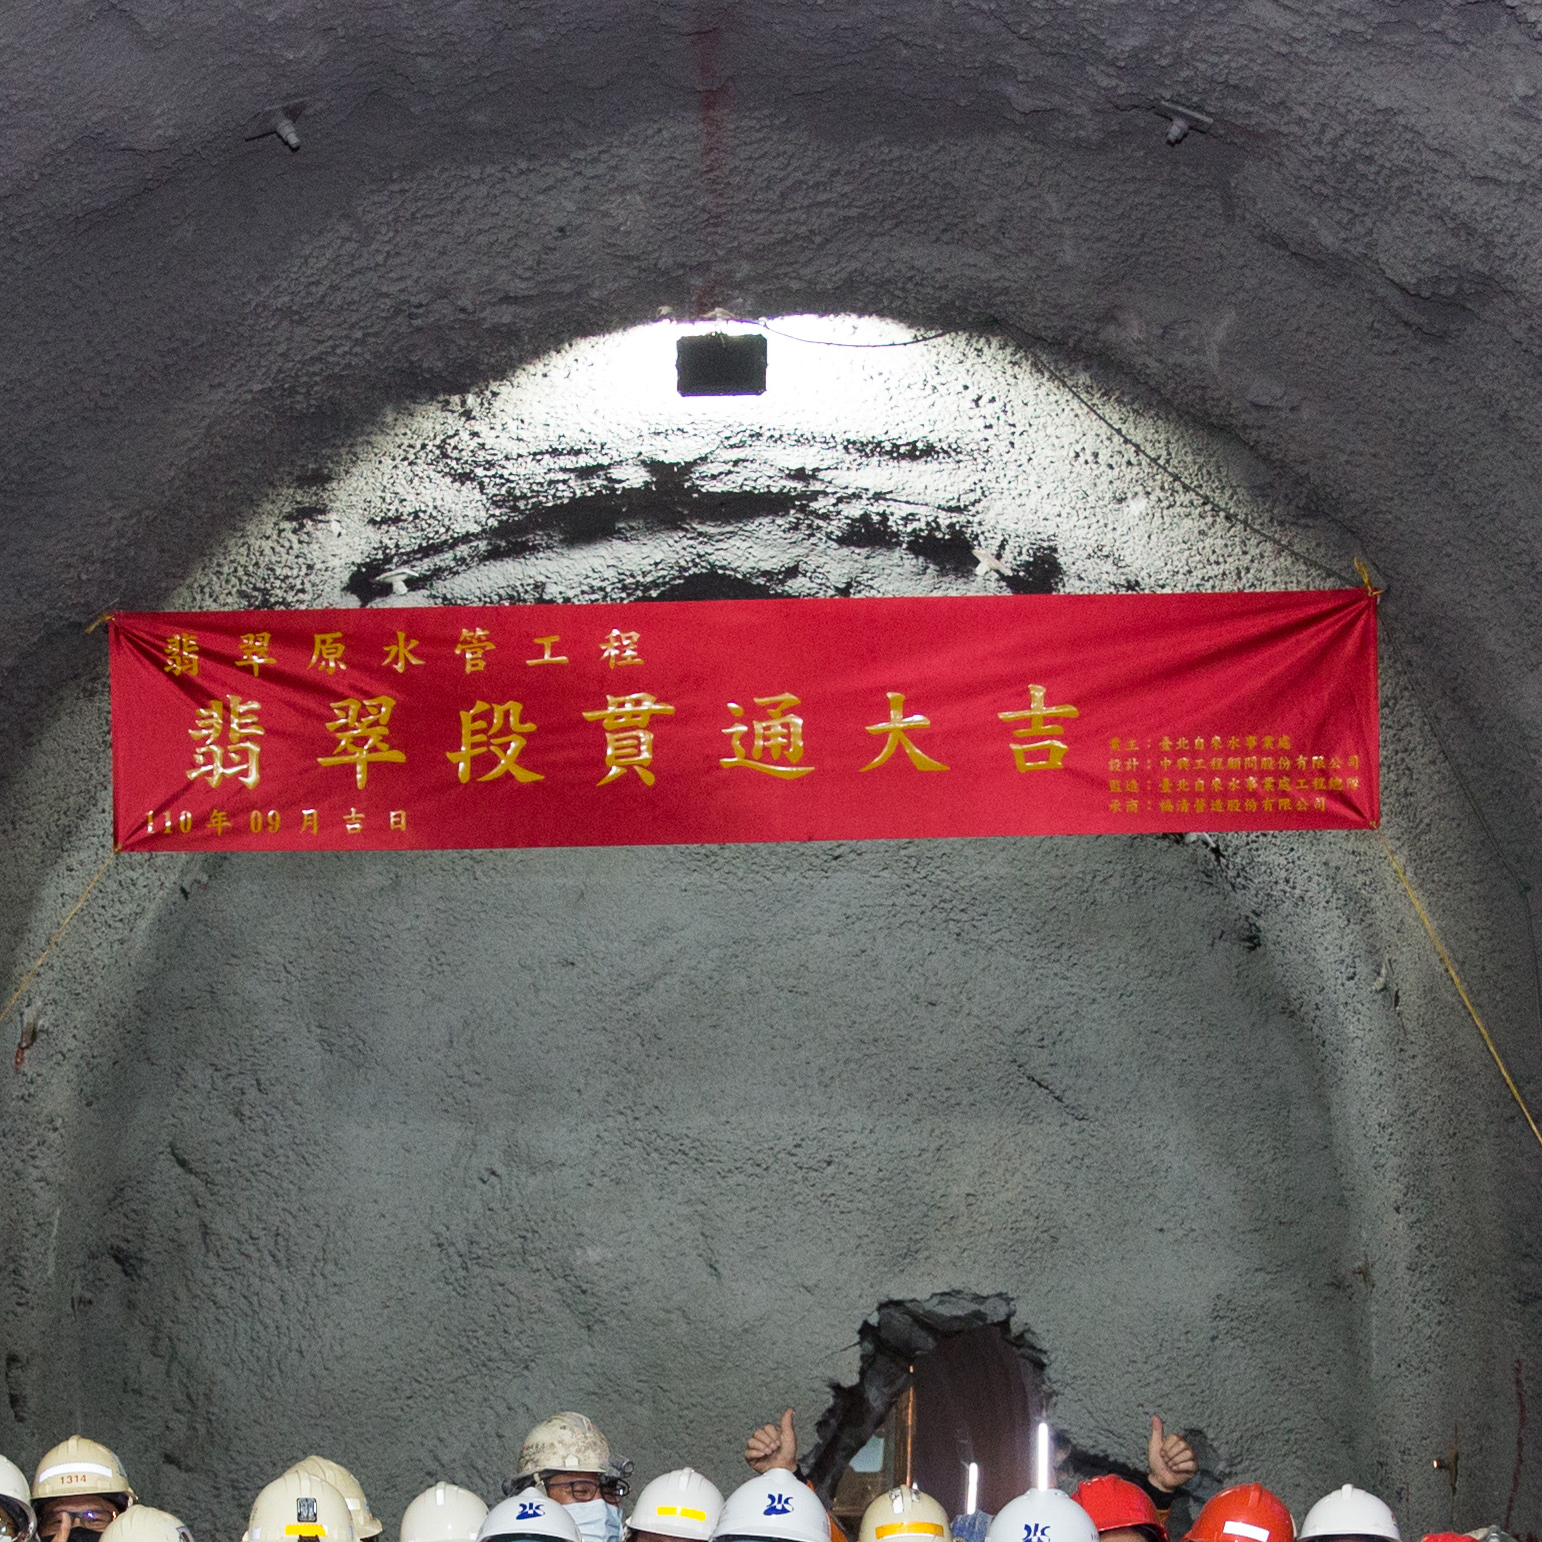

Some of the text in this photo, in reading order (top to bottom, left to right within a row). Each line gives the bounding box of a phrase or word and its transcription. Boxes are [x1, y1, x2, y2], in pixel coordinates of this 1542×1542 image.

[163, 627, 645, 676] 翡翠原水管工程
[186, 683, 1080, 791] 翡翠段貫通大吉
[146, 807, 408, 835] 110年09月吉日
[60, 1474, 87, 1485] 1314
